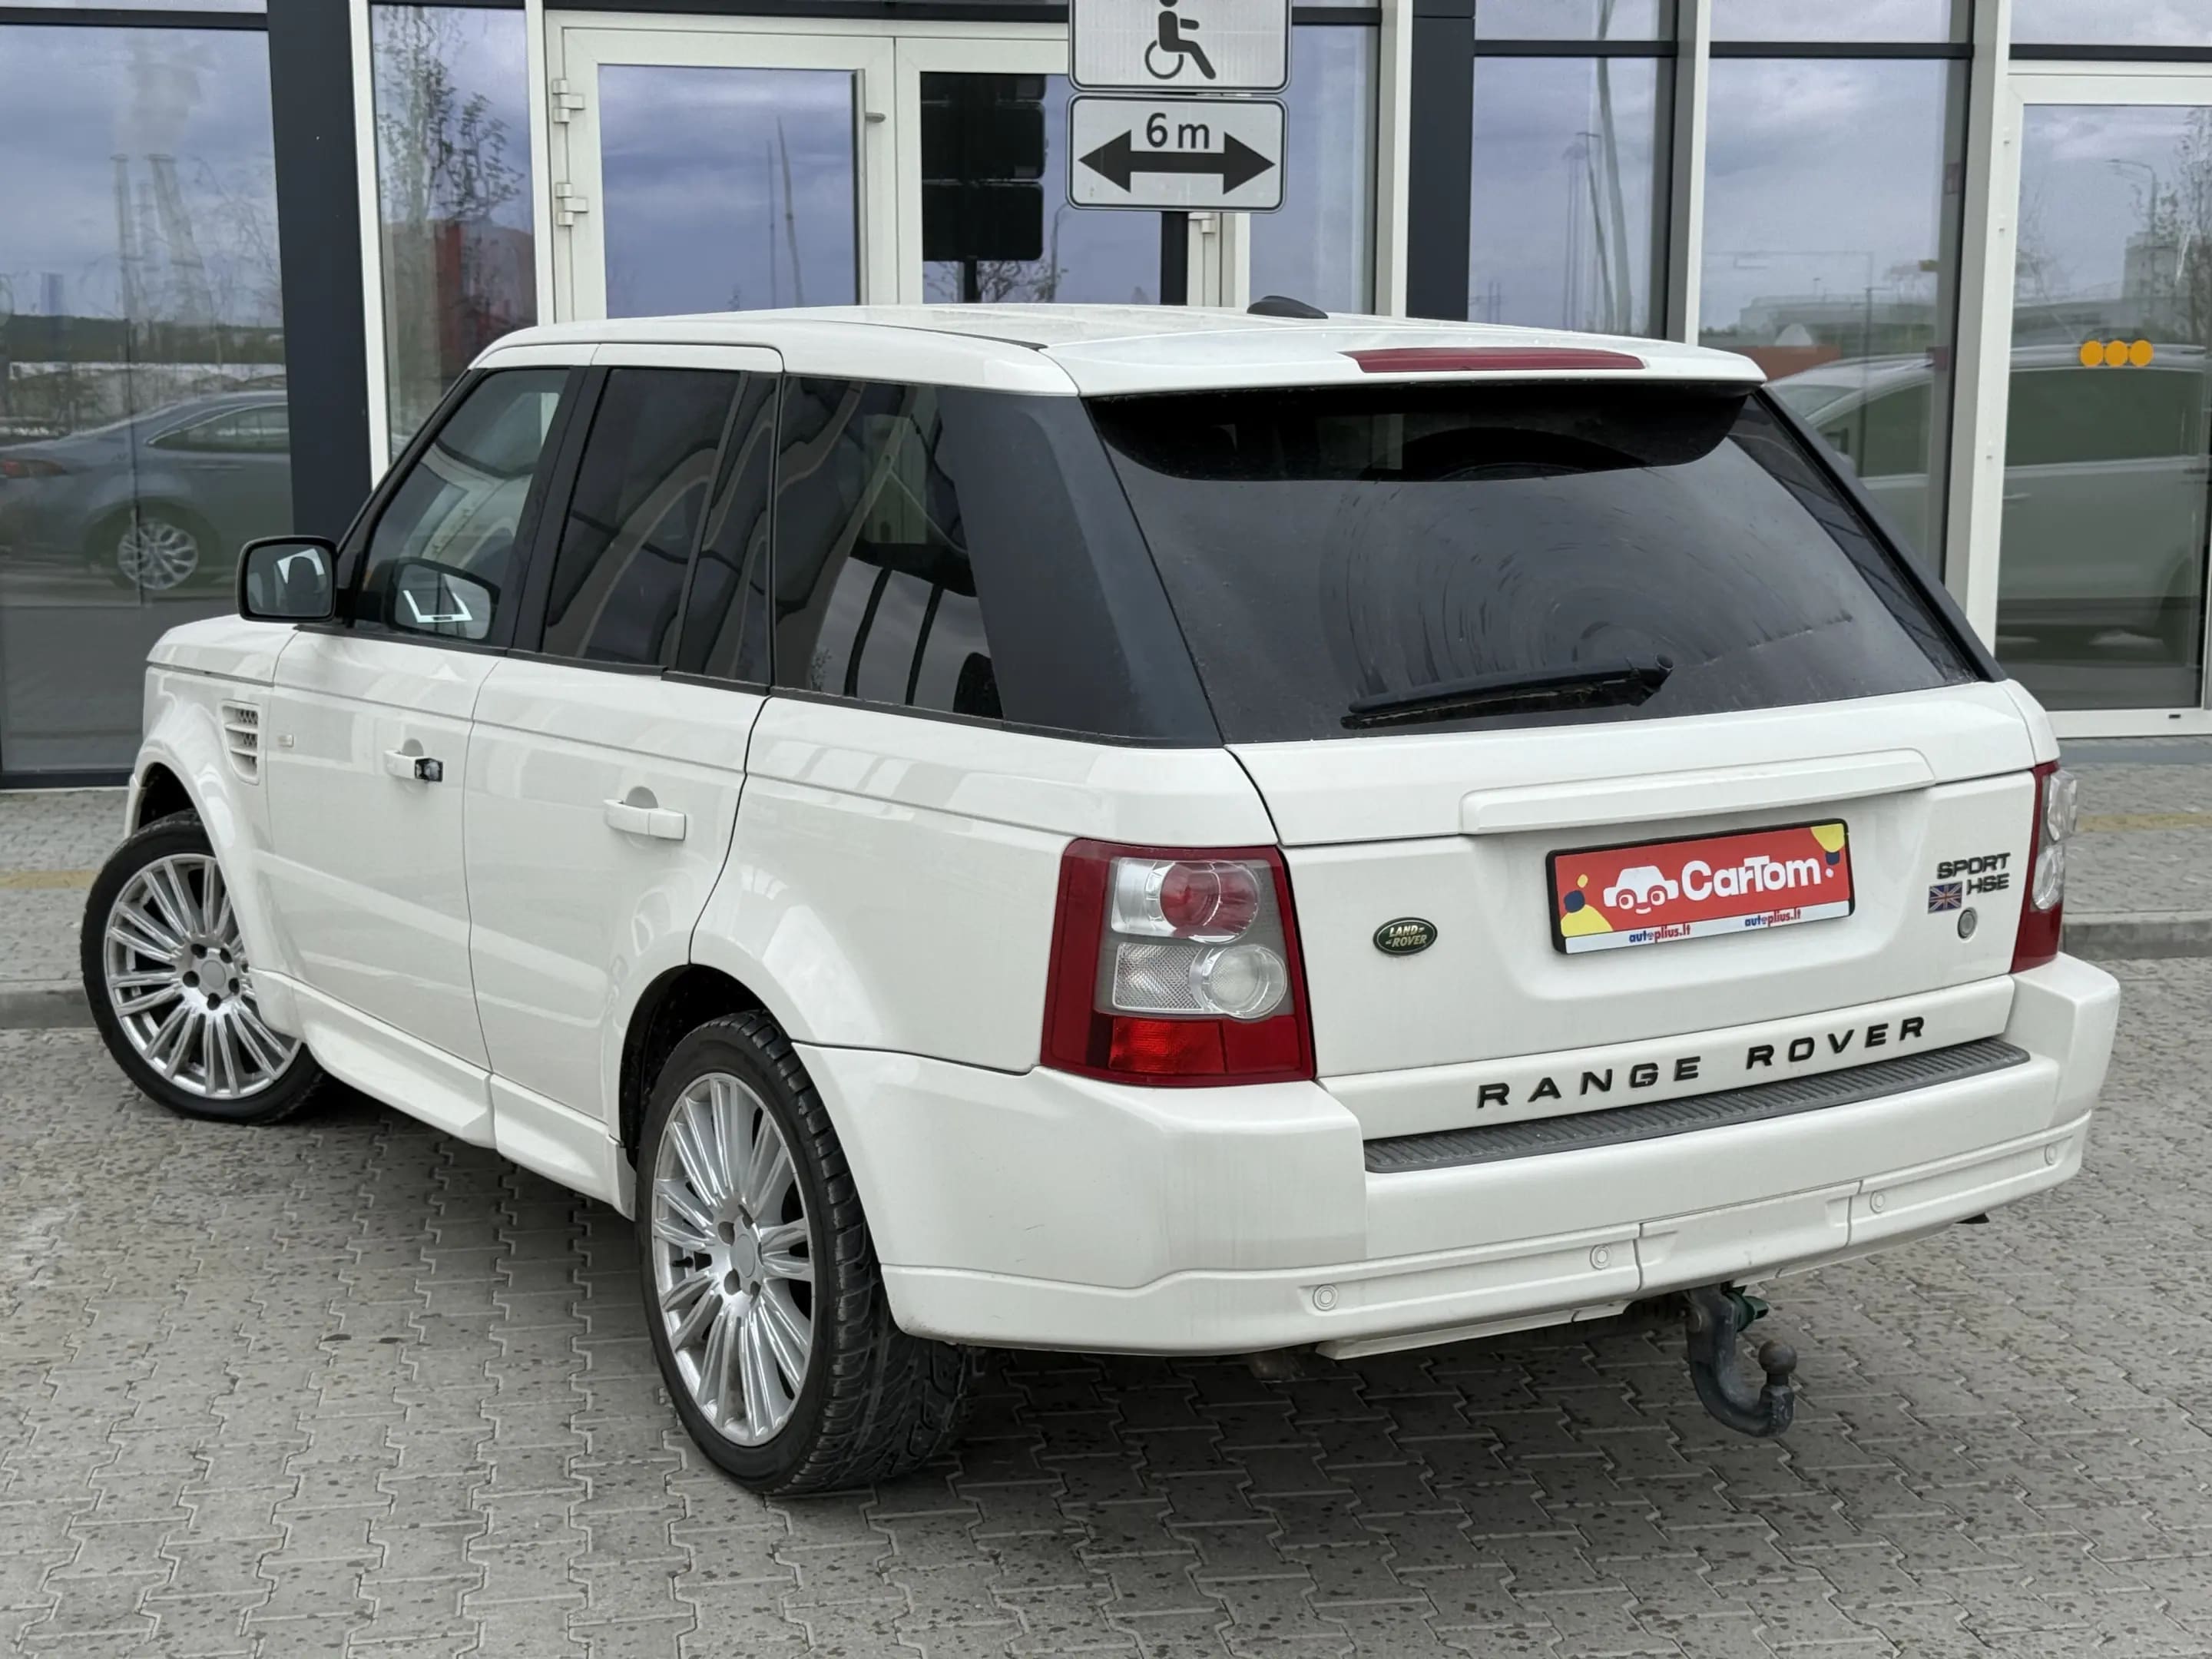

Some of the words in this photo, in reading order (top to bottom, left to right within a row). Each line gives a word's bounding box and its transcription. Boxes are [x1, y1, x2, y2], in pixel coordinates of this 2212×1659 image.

[1681, 855, 1821, 901] CarTom
[1937, 852, 2011, 879] SPORT
[1966, 873, 2010, 896] HSE
[1629, 923, 1690, 943] autoplius.lt
[1477, 1055, 1701, 1108] RANGE
[1746, 1015, 1925, 1070] ROVER
